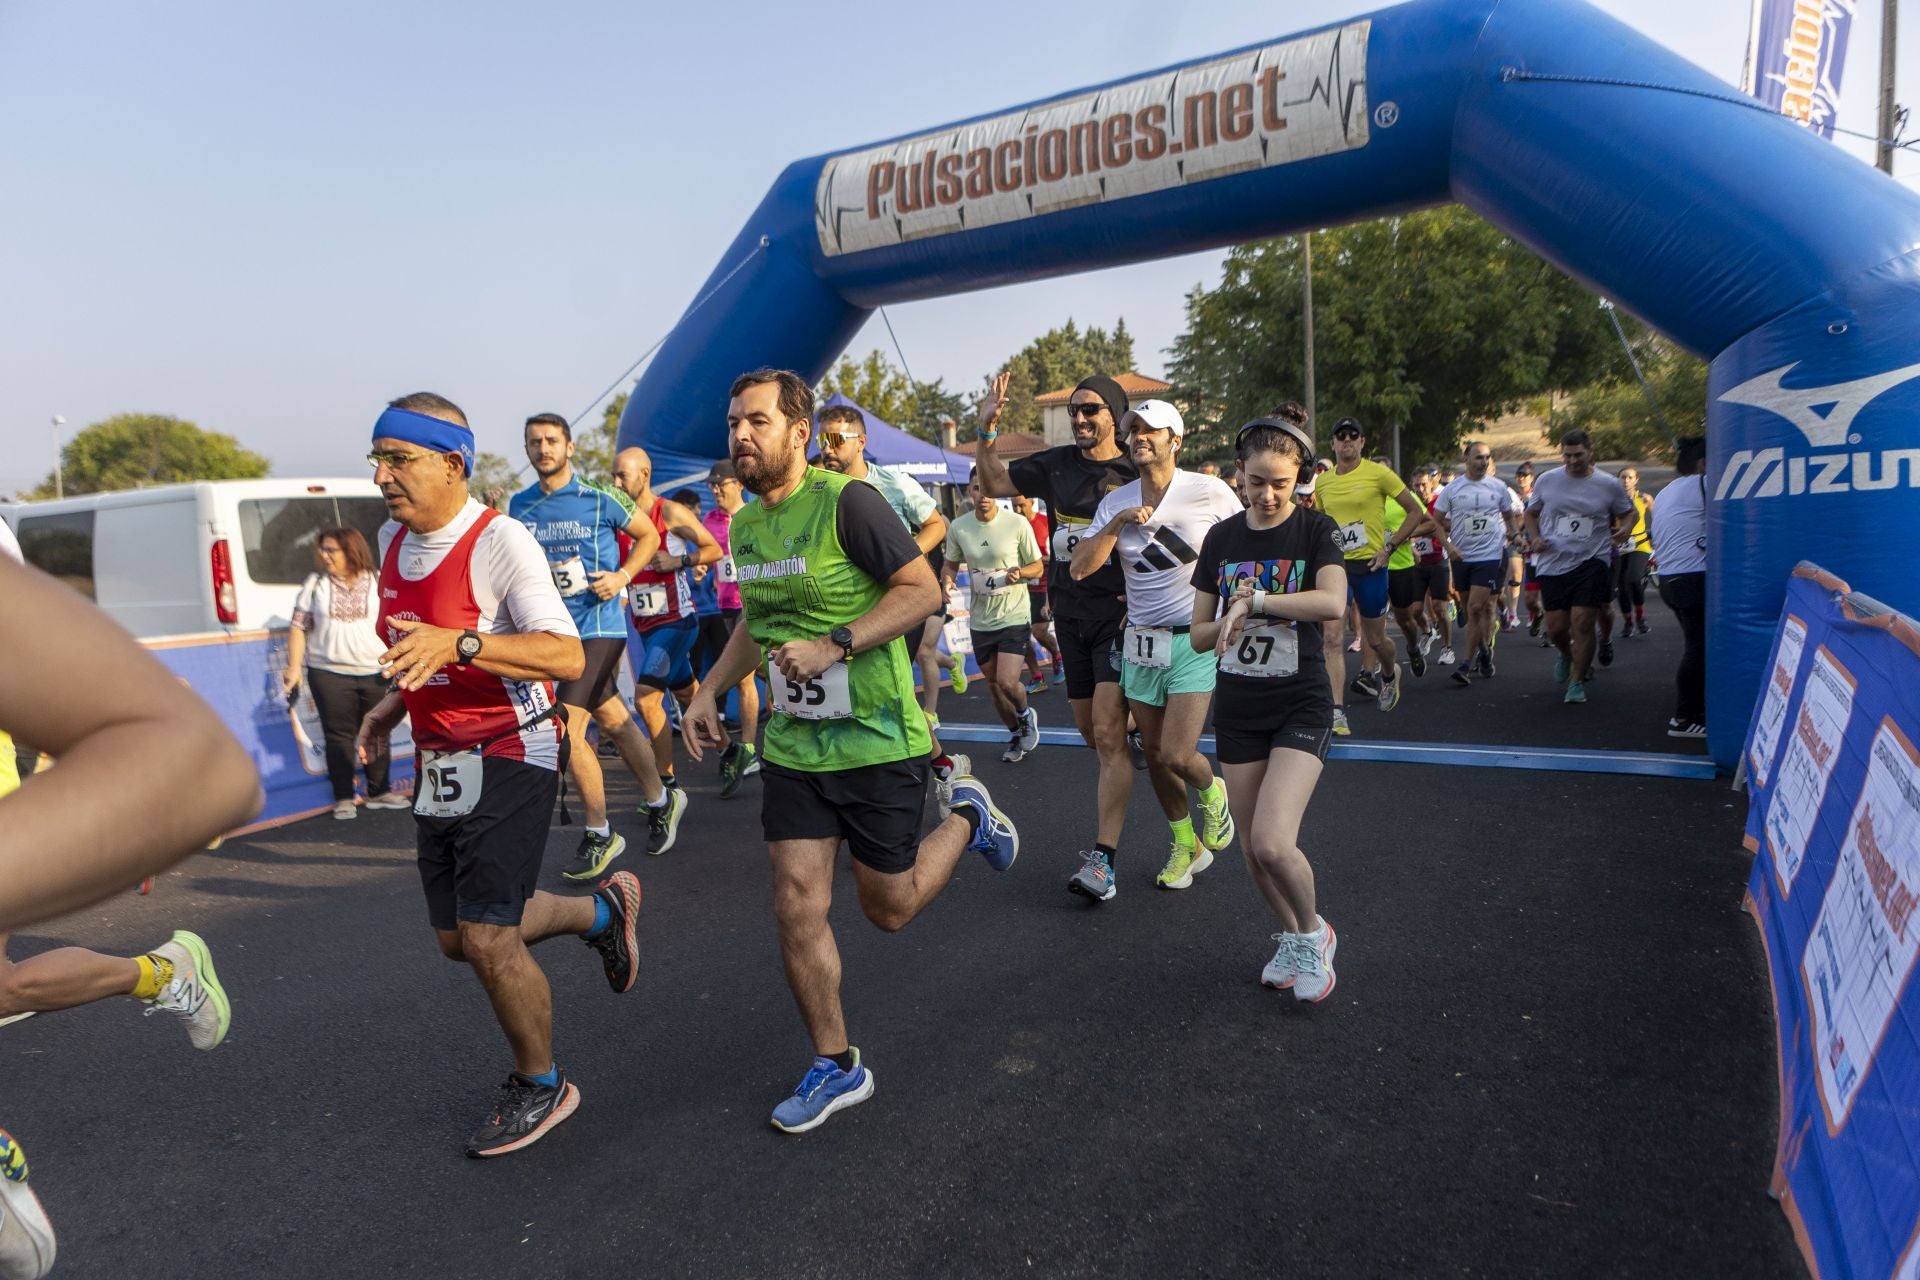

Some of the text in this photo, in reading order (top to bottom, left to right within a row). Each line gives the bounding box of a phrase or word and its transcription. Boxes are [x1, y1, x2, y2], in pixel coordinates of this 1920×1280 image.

[866, 65, 1289, 220] Pulsaciones.net
[537, 526, 592, 538] MEDIADORES
[547, 520, 580, 530] TORRES
[1472, 519, 1488, 530] 57
[1569, 520, 1580, 533] 9
[793, 534, 812, 545] edp
[548, 544, 580, 553] ZURICH
[761, 554, 807, 579] MARATÓN
[985, 576, 996, 590] 4
[636, 592, 654, 610] 51
[1135, 634, 1154, 659] 11
[1237, 635, 1275, 665] 67
[786, 673, 826, 706] 55
[427, 766, 462, 803] 25
